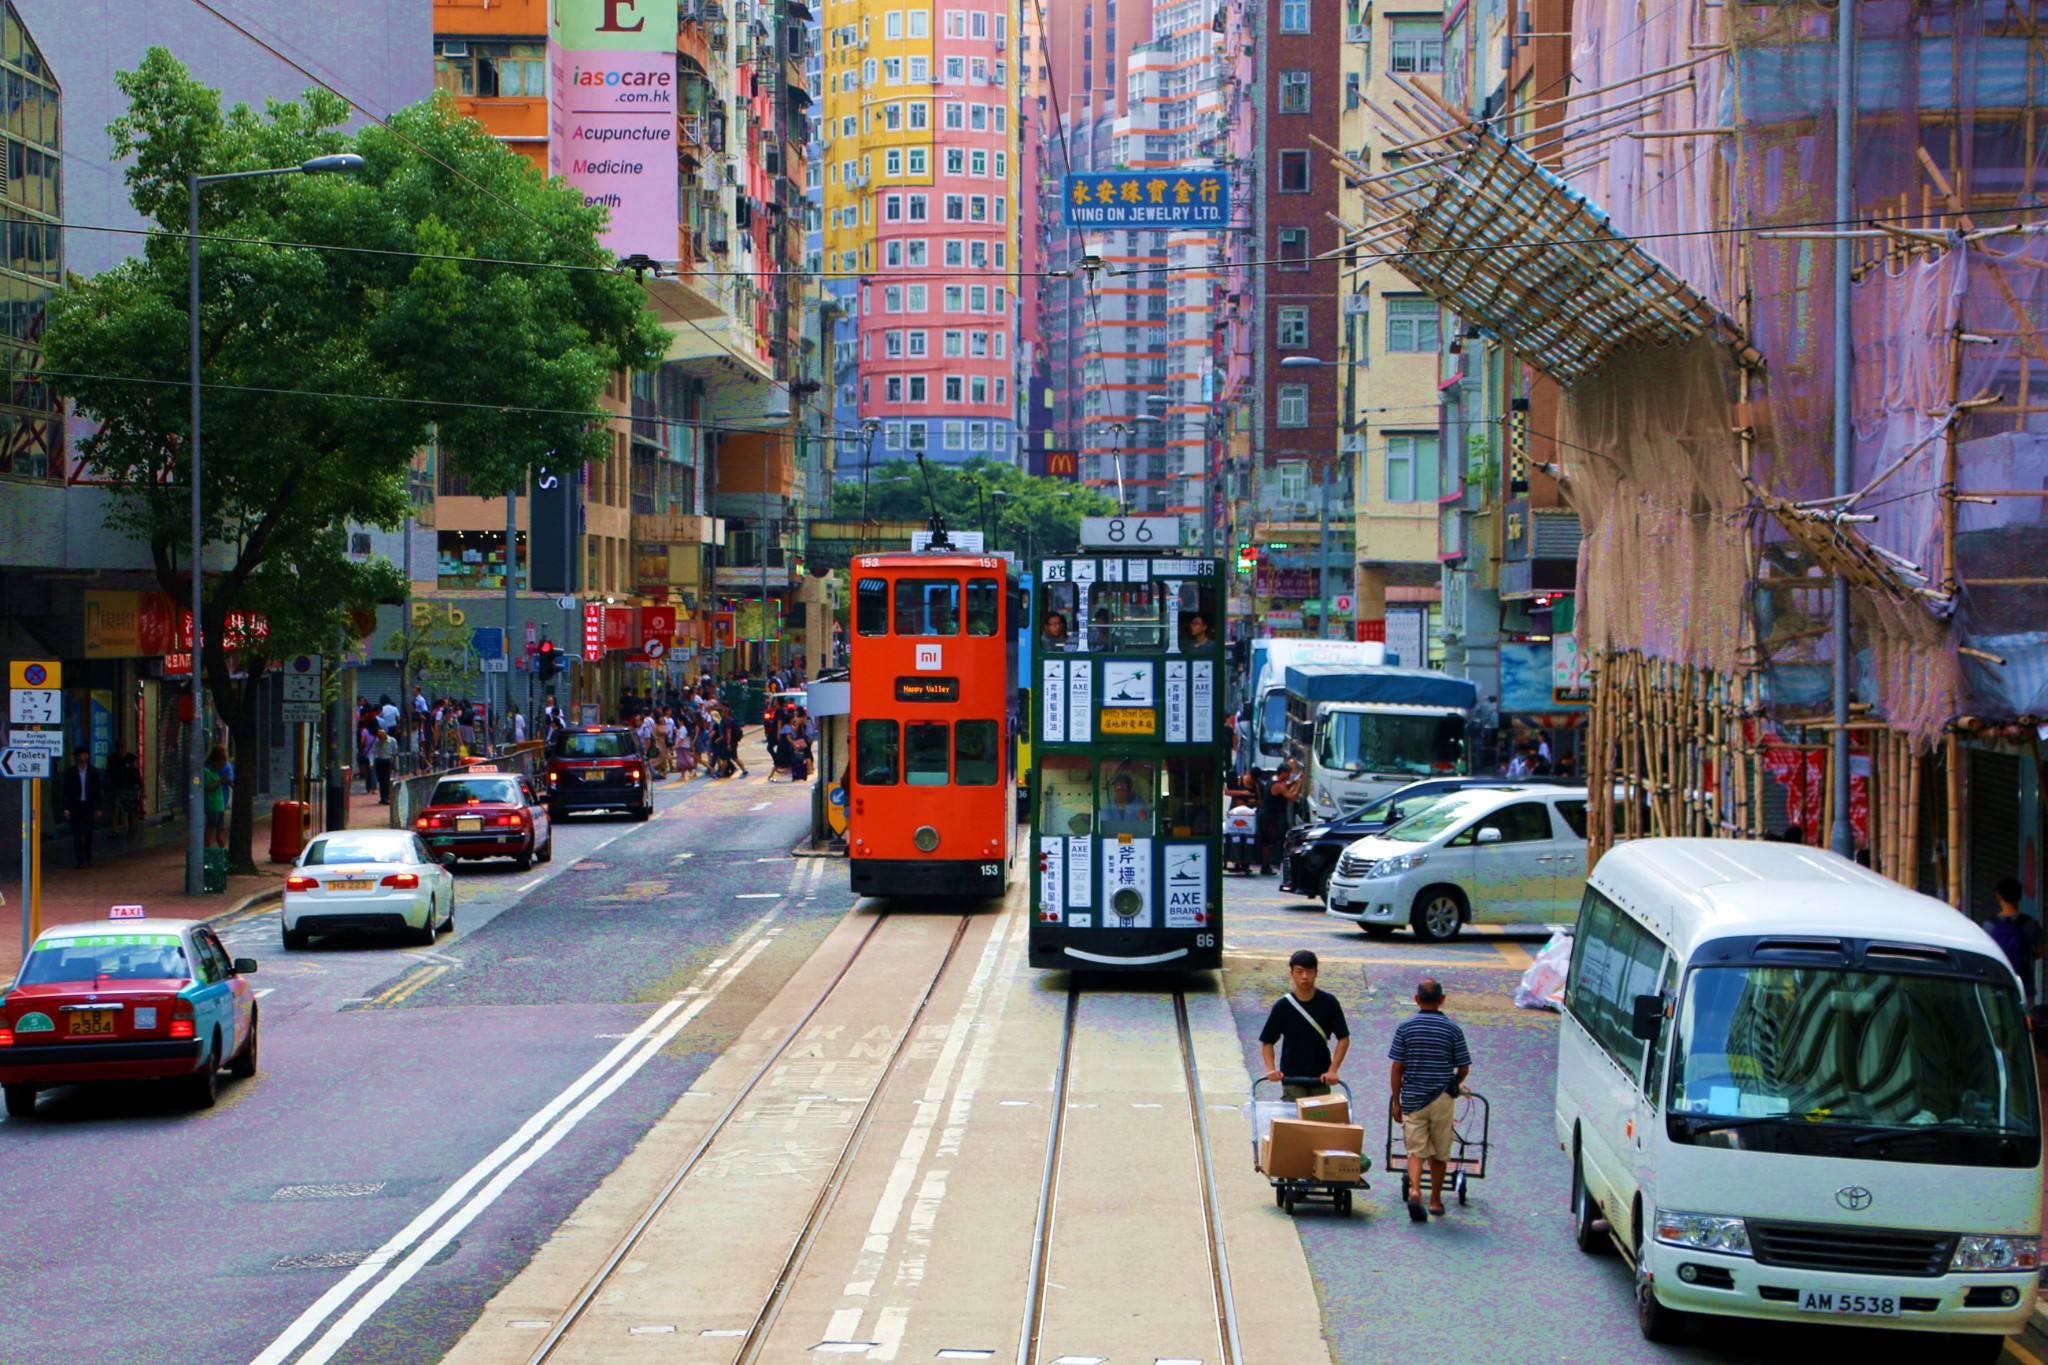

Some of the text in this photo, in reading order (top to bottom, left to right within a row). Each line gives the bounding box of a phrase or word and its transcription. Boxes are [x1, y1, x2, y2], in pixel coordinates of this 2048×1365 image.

[573, 65, 671, 86] iasocare
[615, 90, 671, 103] .com.hk
[572, 125, 671, 143] Acupuncture
[573, 159, 644, 174] Medicine
[1072, 177, 1222, 205] 永安珠寶金行
[583, 194, 622, 208] ealth
[1071, 206, 1222, 222] WING ON JEWELRY LTD.
[1108, 519, 1153, 543] 86
[860, 557, 879, 568] 153
[978, 557, 998, 568] 153
[1049, 565, 1067, 577] 86
[1197, 563, 1214, 576] 86
[903, 685, 950, 693] Happy Valley
[1073, 683, 1089, 691] AXE
[1195, 683, 1209, 691] AXE
[43, 692, 52, 703] 7
[43, 710, 52, 721] 7
[980, 865, 999, 876] 153
[1170, 892, 1201, 905] AXE
[114, 908, 141, 917] TAXI
[1169, 907, 1201, 916] BRAND
[1196, 934, 1215, 947] 86
[81, 1011, 102, 1022] LB
[71, 1021, 112, 1034] 2304
[1805, 1293, 1895, 1314] AM 5538
